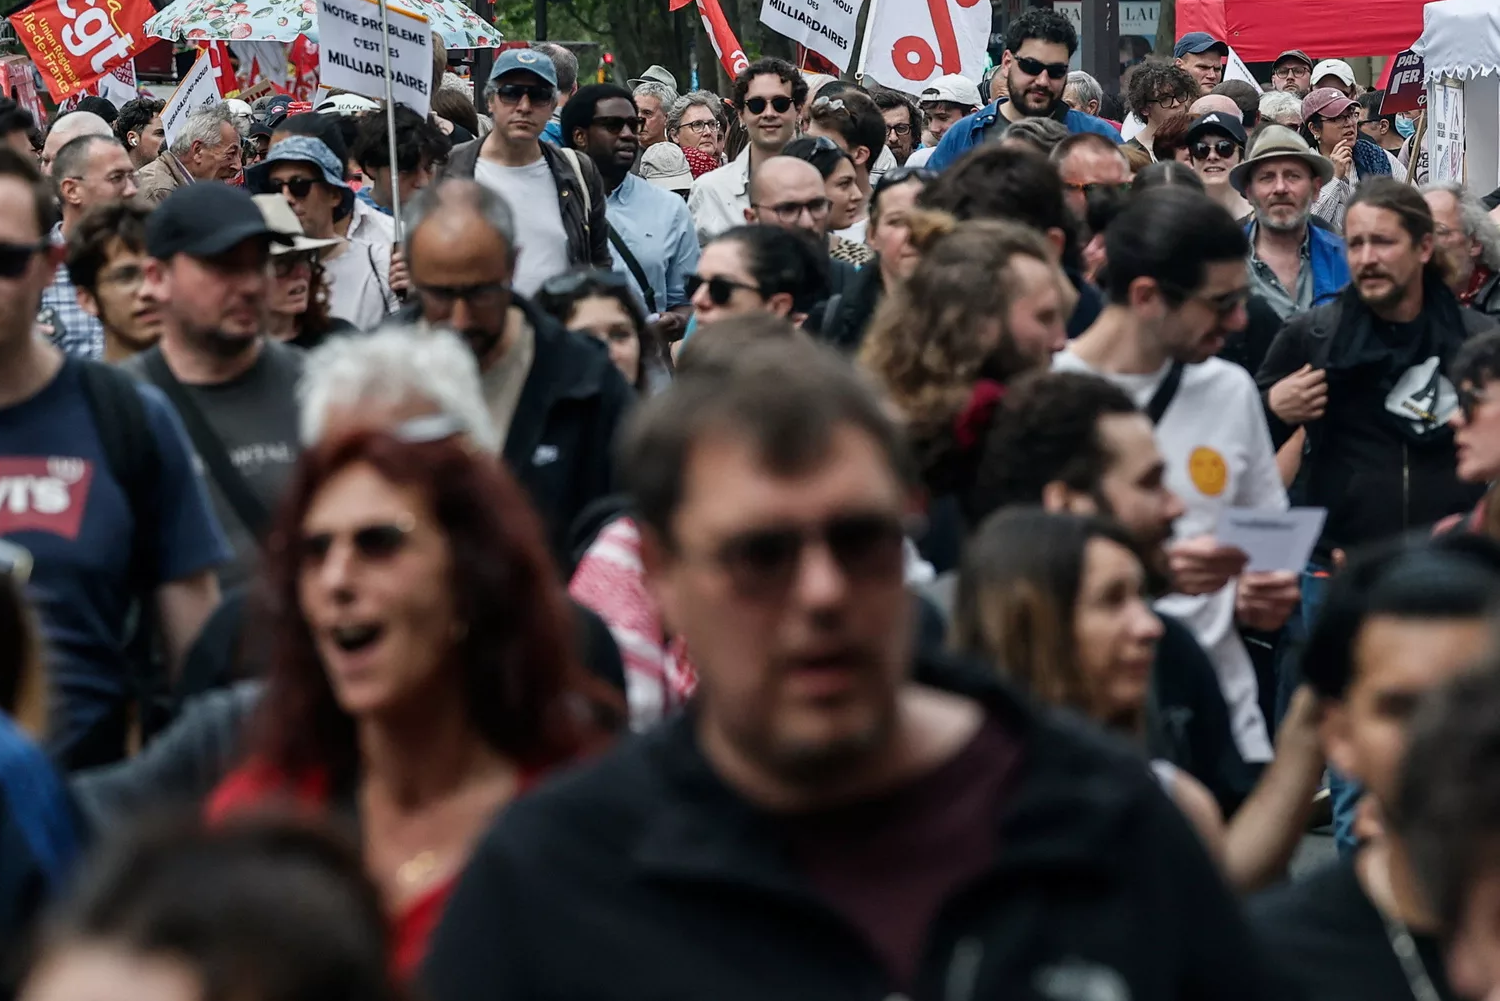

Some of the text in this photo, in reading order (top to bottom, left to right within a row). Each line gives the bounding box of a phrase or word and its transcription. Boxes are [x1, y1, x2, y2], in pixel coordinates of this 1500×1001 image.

[323, 1, 360, 25] NOTRE
[23, 11, 70, 94] Île-de-France
[38, 17, 56, 44] Union
[52, 40, 81, 89] Régionale
[353, 37, 400, 59] C'EST ES
[1396, 53, 1421, 68] PAS
[1389, 68, 1421, 95] 1ER
